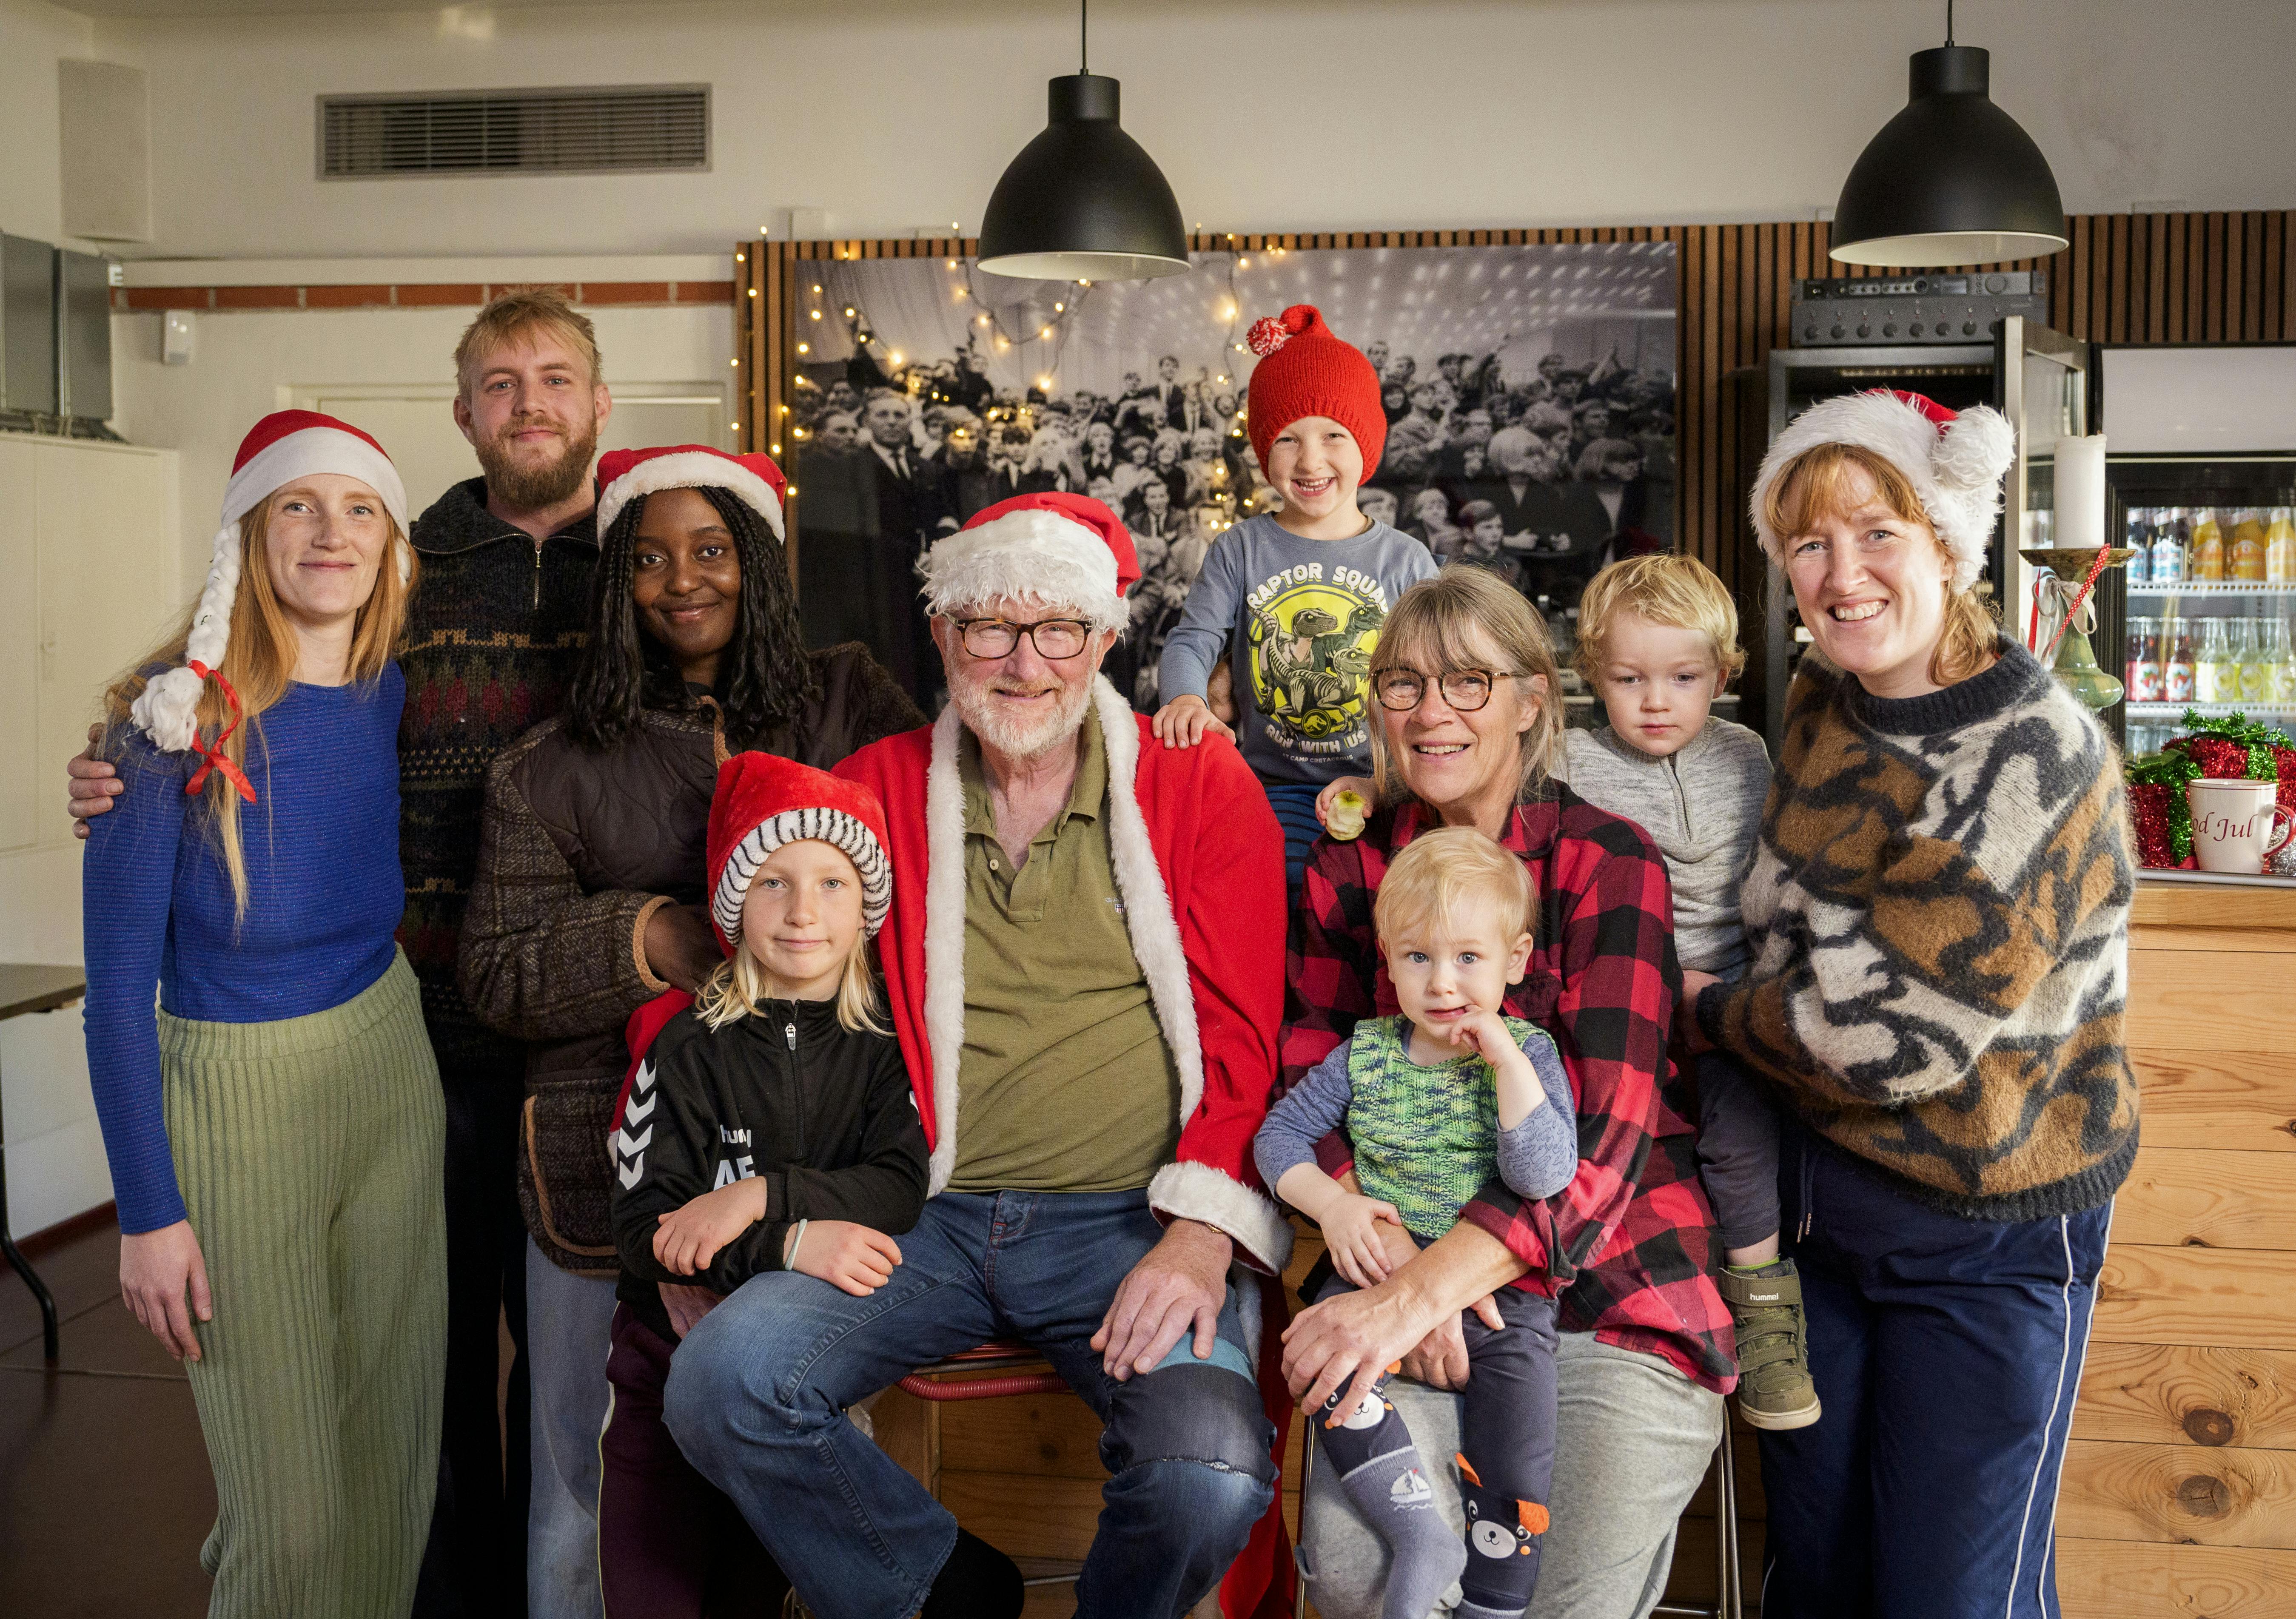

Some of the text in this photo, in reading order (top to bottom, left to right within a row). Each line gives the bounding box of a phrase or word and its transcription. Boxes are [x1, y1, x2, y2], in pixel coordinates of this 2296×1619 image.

[1246, 562, 1323, 610] RAPTOR
[1265, 724, 1367, 754] RUN WITH US
[1309, 754, 1354, 763] CRETACEOUS
[2192, 811, 2258, 842] od Jul
[1750, 1292, 1779, 1301] hummel
